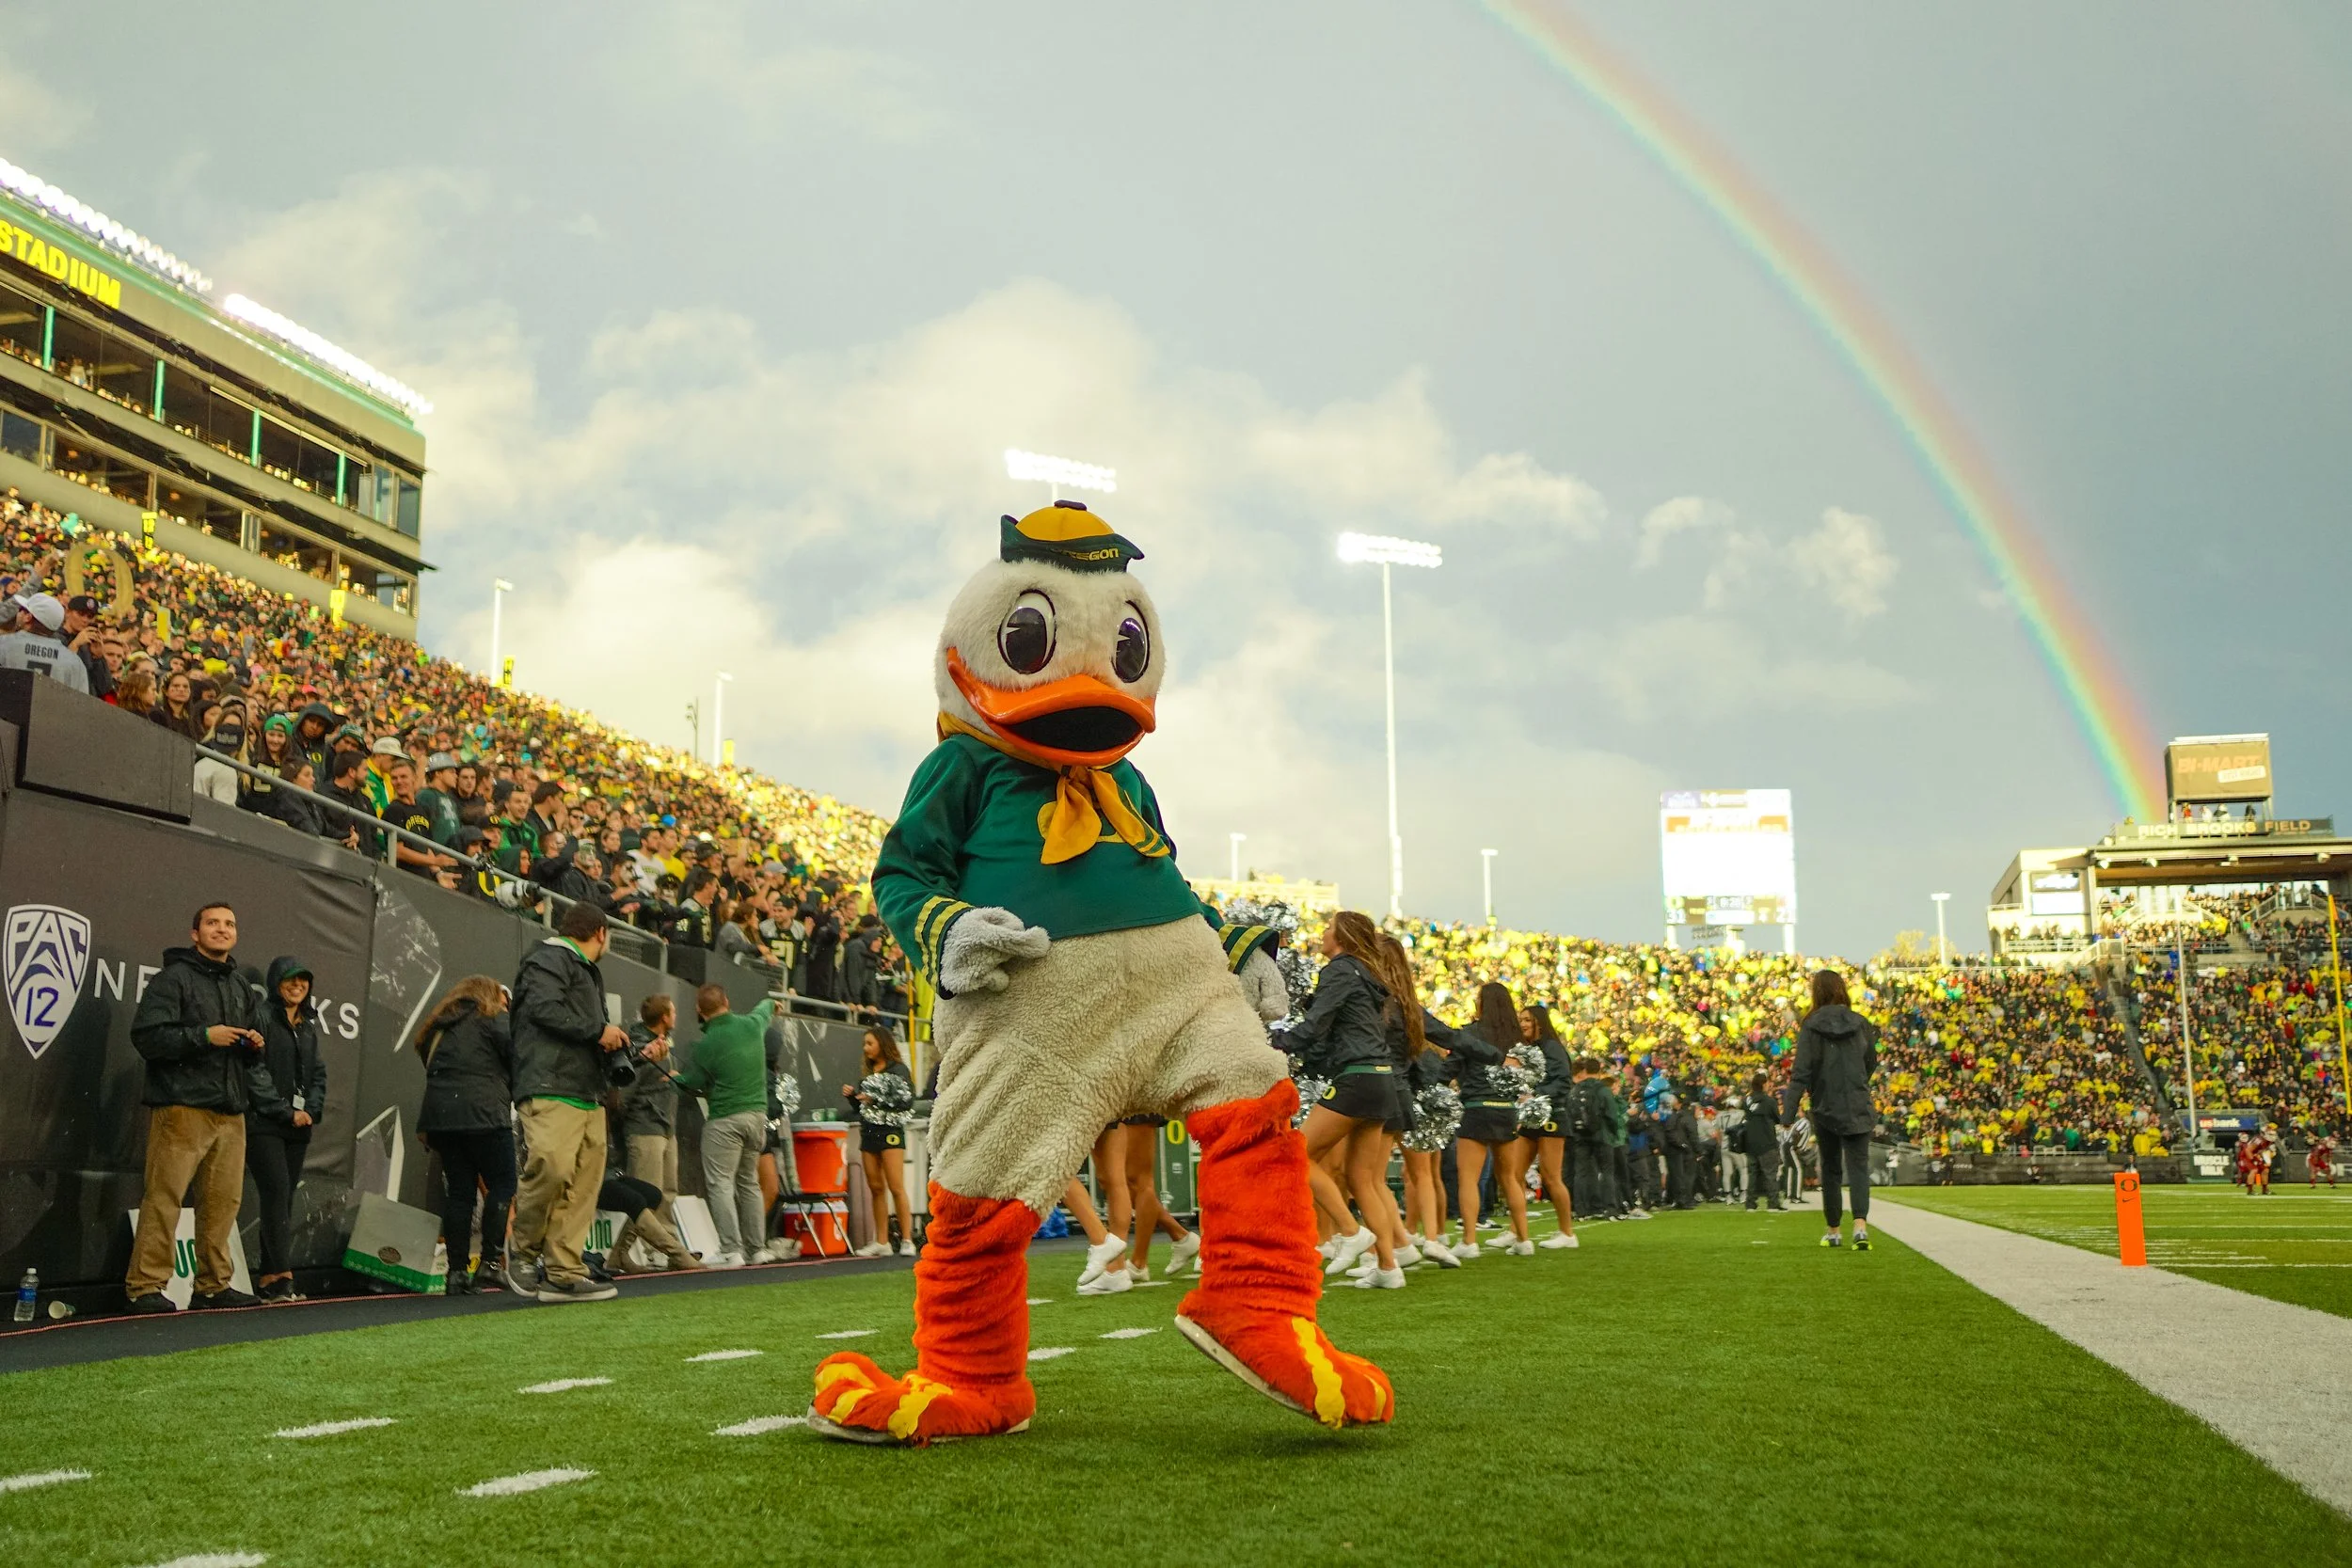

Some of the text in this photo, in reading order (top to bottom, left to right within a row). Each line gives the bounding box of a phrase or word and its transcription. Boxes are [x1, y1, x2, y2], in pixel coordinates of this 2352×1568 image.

[0, 219, 121, 309] STADIUM
[24, 643, 59, 659] OREGON
[2138, 820, 2311, 836] RICH BROOKS FIELD
[8, 910, 89, 997] PAC
[24, 986, 59, 1027] 12
[2193, 1154, 2230, 1166] MUSCLE
[2120, 1179, 2137, 1192] O
